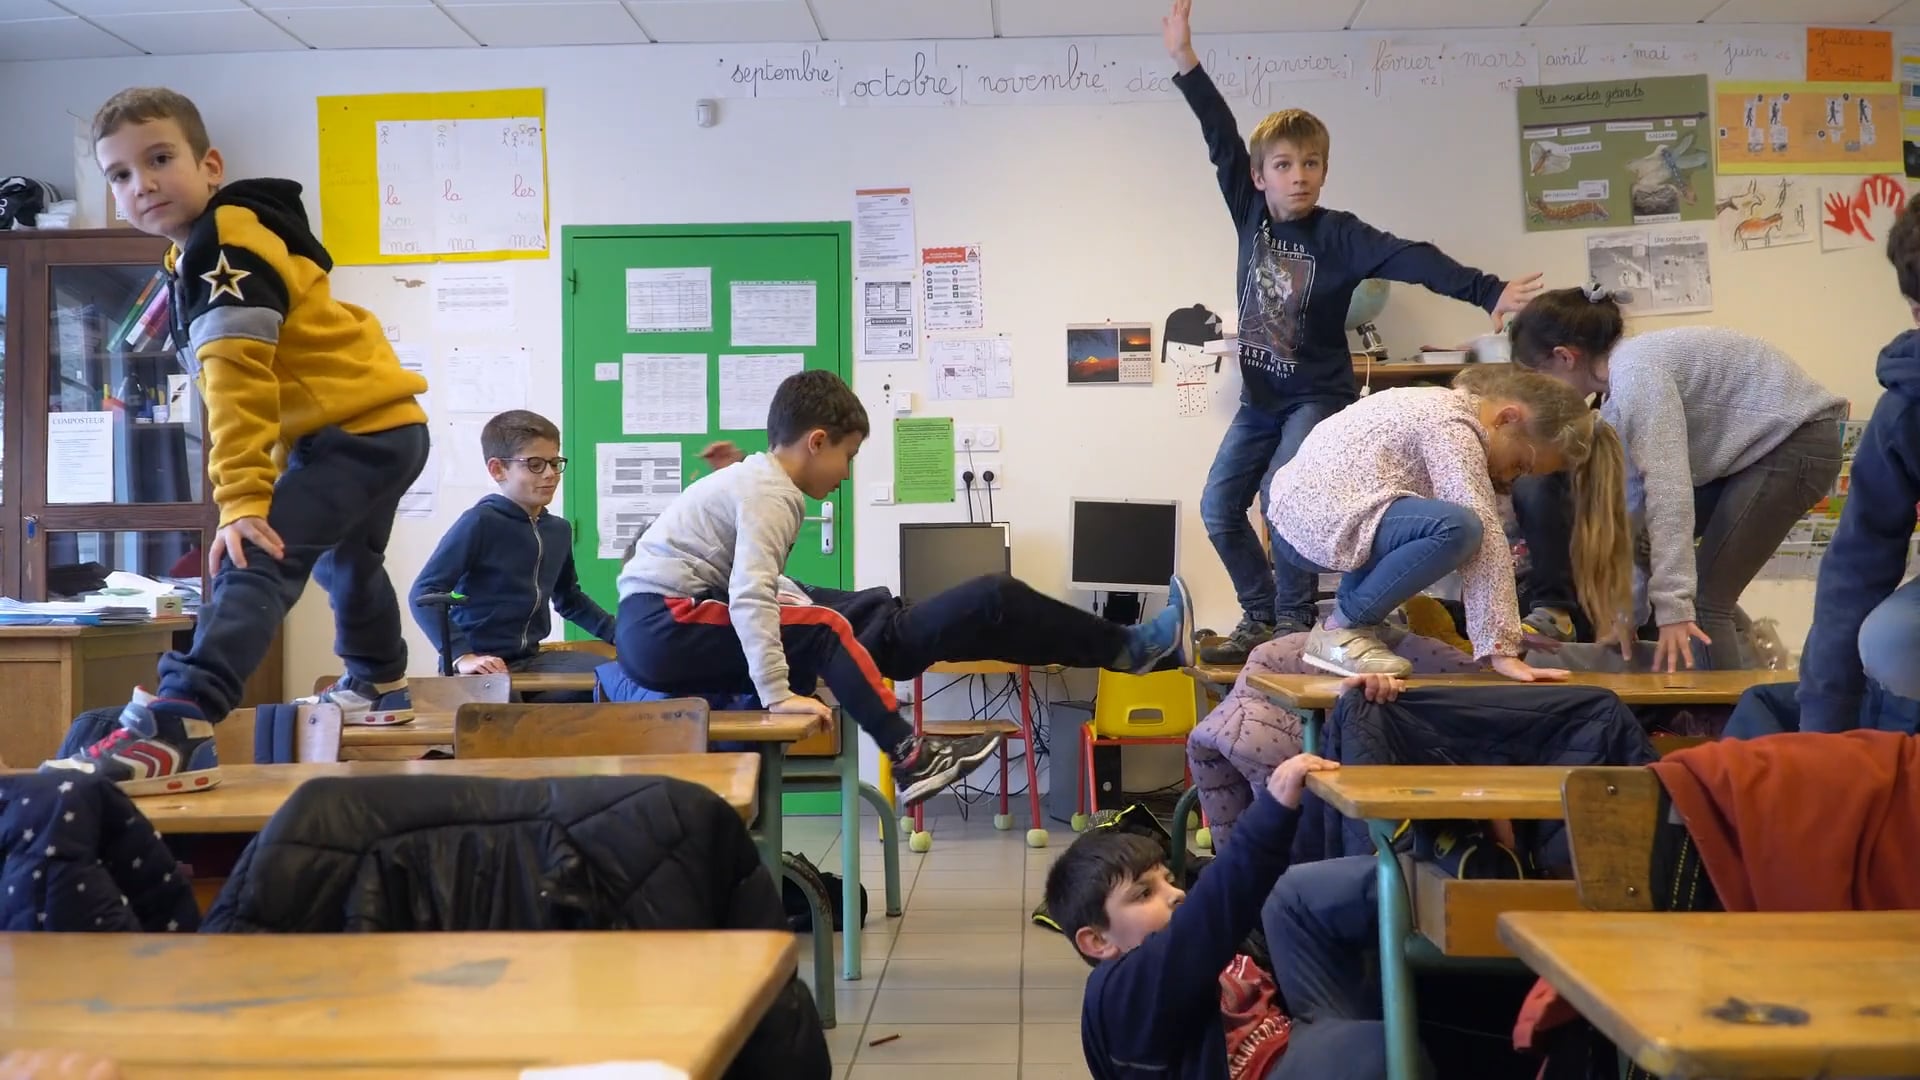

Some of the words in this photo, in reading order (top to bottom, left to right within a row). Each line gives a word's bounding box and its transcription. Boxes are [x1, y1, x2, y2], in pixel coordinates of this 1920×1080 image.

[1460, 49, 1527, 68] mars
[1544, 44, 1589, 66] avril
[1632, 44, 1671, 61] mai
[1723, 42, 1769, 76] juin
[730, 49, 834, 98] septembre
[853, 51, 958, 97] octobre
[978, 43, 1104, 94] novembre
[1124, 48, 1240, 93] décbre
[1369, 39, 1435, 98] février
[1251, 55, 1337, 107] janvier
[385, 184, 402, 205] le
[441, 178, 463, 201] la
[511, 174, 537, 198] les
[447, 237, 477, 251] ma
[52, 416, 105, 425] COMPOSTEUR
